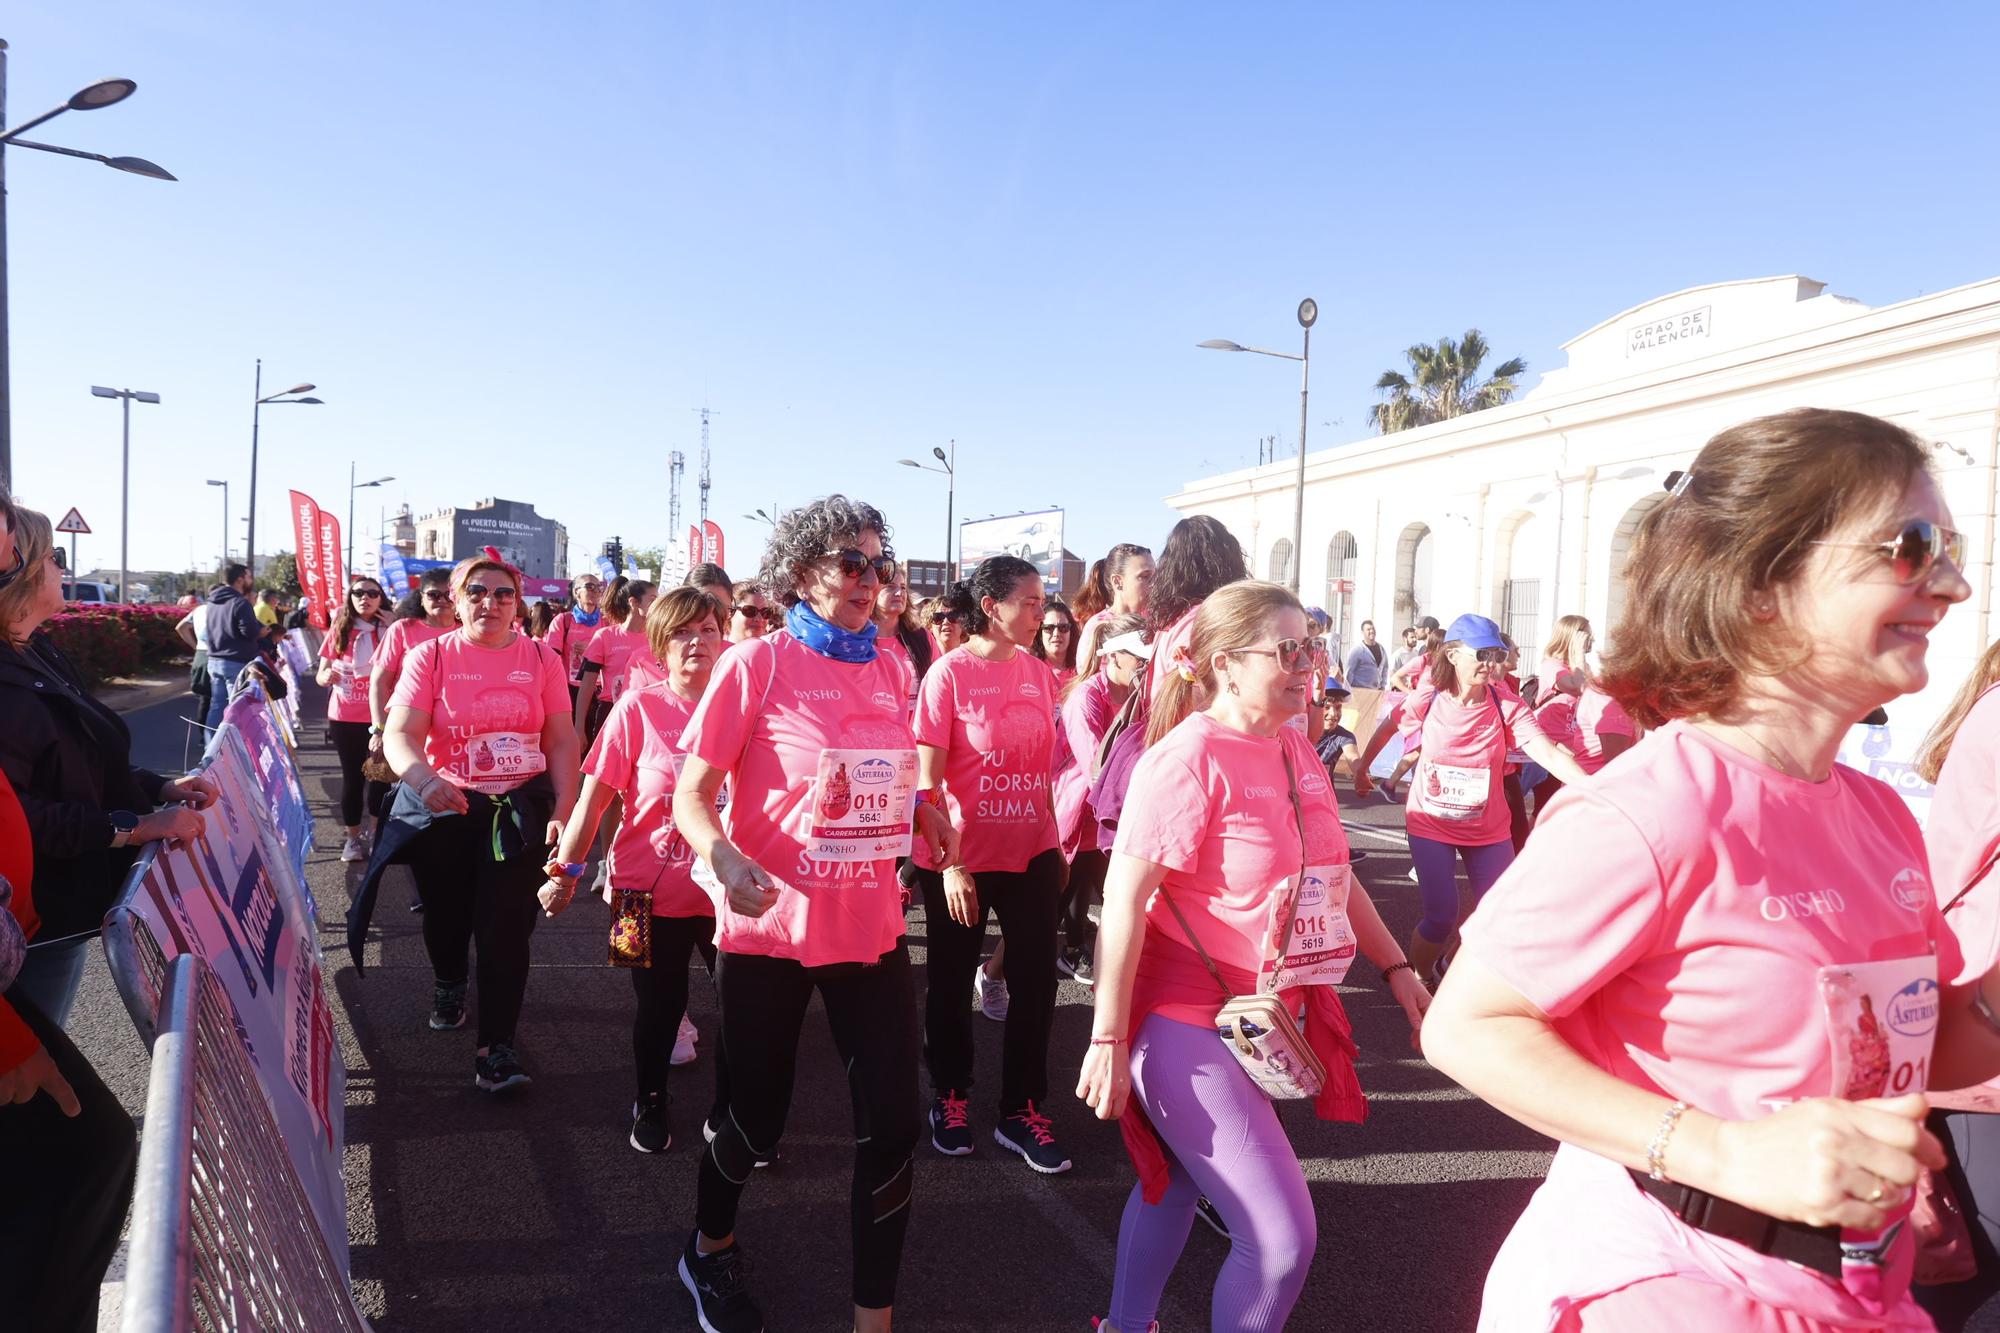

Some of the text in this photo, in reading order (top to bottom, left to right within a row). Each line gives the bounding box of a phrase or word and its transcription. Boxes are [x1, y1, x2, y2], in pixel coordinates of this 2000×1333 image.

[1635, 312, 1702, 339] GRAO DE
[1632, 325, 1704, 351] VALENCIA
[471, 518, 497, 527] PUERTO
[793, 689, 841, 701] OYSHO
[969, 686, 1001, 697] OYSHO
[447, 724, 474, 739] TU
[497, 755, 522, 766] 016
[855, 769, 893, 779] ASTURIANA
[979, 772, 1048, 793] DORSAL
[1442, 786, 1465, 797] 016
[853, 793, 888, 810] 016
[977, 799, 1037, 817] SUMA
[819, 844, 857, 854] OYSHO
[796, 849, 876, 879] SUMA
[1760, 888, 1845, 921] OYSHO
[1295, 914, 1327, 935] 016
[1302, 937, 1324, 950] 5619
